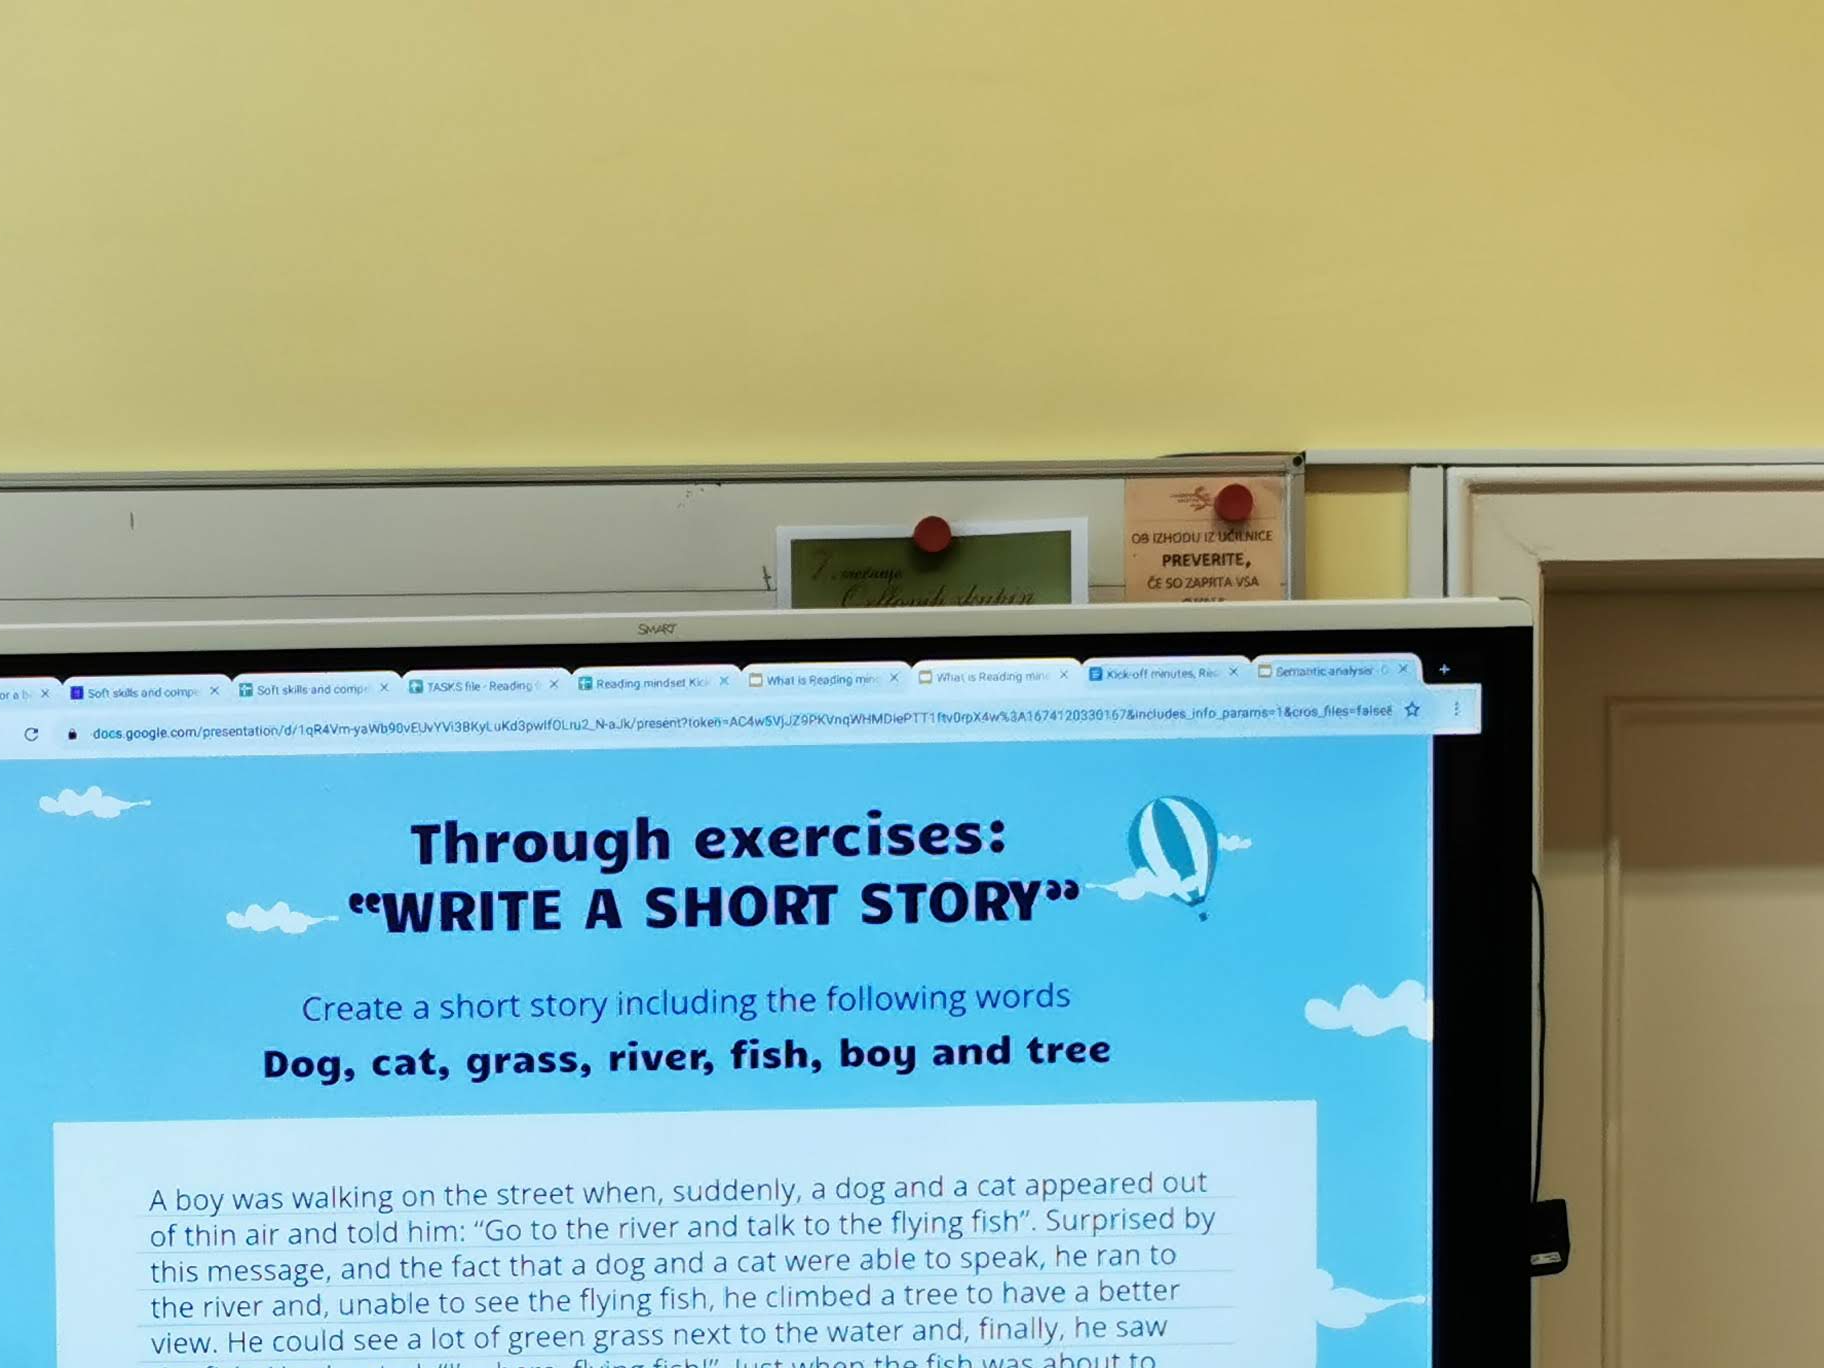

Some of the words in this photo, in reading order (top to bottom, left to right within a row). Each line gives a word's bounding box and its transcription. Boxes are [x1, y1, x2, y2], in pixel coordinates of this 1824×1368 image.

[1131, 532, 1150, 545] OB
[1152, 531, 1201, 545] IZHODU
[1204, 531, 1215, 544] IZ
[1162, 552, 1252, 569] PREVERITE,
[1147, 575, 1163, 590] ČE
[1165, 577, 1183, 590] SO
[1185, 575, 1233, 590] ZAPRTA
[1236, 575, 1260, 588] VSA
[638, 623, 677, 636] SMART
[937, 671, 966, 683] What
[979, 670, 1023, 684] Reading
[1107, 669, 1148, 680] Kick-off
[1276, 666, 1326, 678] Semantic
[1328, 665, 1373, 679] analysis
[427, 681, 463, 693] TASKS
[465, 681, 480, 692] file
[489, 680, 533, 694] Reading
[597, 677, 640, 691] Reading
[643, 677, 686, 688] mindset
[767, 675, 795, 686] What
[809, 674, 853, 687] Reading
[87, 687, 110, 699] Soft
[112, 686, 138, 699] skills
[141, 686, 163, 698] and
[257, 684, 279, 696] Soft
[282, 684, 308, 695] skills
[311, 683, 332, 695] and
[411, 817, 669, 871] Through
[696, 810, 1006, 865] exercises:
[347, 889, 560, 935] “WRITE
[585, 889, 622, 930] A
[646, 883, 840, 927] SHORT
[860, 876, 1082, 924] STORY”
[302, 995, 403, 1022] Create
[412, 999, 430, 1020] a
[439, 992, 521, 1021] short
[529, 993, 609, 1025] story
[615, 987, 758, 1022] including
[765, 986, 817, 1014] the
[825, 983, 967, 1018] following
[975, 981, 1071, 1010] words
[263, 1049, 356, 1087] Dog,
[371, 1047, 450, 1082] cat,
[466, 1049, 592, 1084] grass,
[608, 1039, 719, 1078] river,
[727, 1037, 826, 1076] fish,
[838, 1036, 920, 1076] boy
[931, 1033, 1018, 1070] and
[1023, 1033, 1112, 1067] tree
[148, 1189, 168, 1212] A
[176, 1188, 225, 1218] boy
[231, 1191, 284, 1211] was
[291, 1185, 394, 1215] walking
[401, 1189, 435, 1208] on
[443, 1183, 488, 1207] the
[496, 1183, 575, 1206] street
[582, 1180, 664, 1207] when,
[672, 1177, 802, 1208] suddenly,
[811, 1182, 826, 1201] a
[835, 1176, 886, 1206] dog
[893, 1174, 944, 1199] and
[953, 1179, 968, 1198] a
[977, 1175, 1017, 1197] cat
[1025, 1170, 1153, 1203] appeared
[1162, 1171, 1208, 1194] out
[150, 1222, 179, 1248] of
[184, 1223, 237, 1248] thin
[245, 1223, 280, 1247] air
[287, 1220, 337, 1246] and
[346, 1220, 398, 1245] told
[408, 1219, 465, 1244] him:
[473, 1218, 522, 1242] “Go
[530, 1219, 558, 1241] to
[565, 1216, 610, 1241] the
[619, 1216, 680, 1239] river
[687, 1213, 738, 1239] and
[746, 1213, 796, 1238] talk
[803, 1214, 830, 1237] to
[838, 1211, 883, 1236] the
[890, 1209, 964, 1241] flying
[971, 1208, 1037, 1234] fish”.
[1046, 1206, 1175, 1238] Surprised
[1184, 1205, 1216, 1236] by
[149, 1259, 199, 1284] this
[207, 1262, 331, 1288] message,
[340, 1255, 391, 1281] and
[399, 1255, 443, 1280] the
[451, 1253, 501, 1278] fact
[509, 1253, 563, 1278] that
[571, 1258, 586, 1277] a
[595, 1252, 646, 1282] dog
[653, 1250, 704, 1275] and
[713, 1255, 728, 1274] a
[737, 1251, 777, 1273] cat
[784, 1253, 851, 1272] were
[859, 1246, 916, 1272] able
[924, 1248, 952, 1270] to
[960, 1244, 1046, 1276] speak,
[1055, 1244, 1088, 1268] he
[1097, 1248, 1140, 1267] ran
[1150, 1244, 1177, 1266] to
[150, 1295, 194, 1320] the
[203, 1295, 264, 1319] river
[271, 1292, 329, 1320] and,
[339, 1291, 430, 1316] unable
[438, 1292, 465, 1315] to
[474, 1295, 520, 1314] see
[528, 1288, 571, 1313] the
[578, 1287, 653, 1319] flying
[659, 1285, 715, 1313] fish,
[724, 1285, 757, 1310] he
[765, 1283, 871, 1309] climbed
[880, 1288, 895, 1307] a
[903, 1285, 958, 1306] tree
[966, 1283, 993, 1305] to
[1002, 1280, 1066, 1305] have
[1074, 1284, 1089, 1303] a
[1099, 1279, 1181, 1303] better
